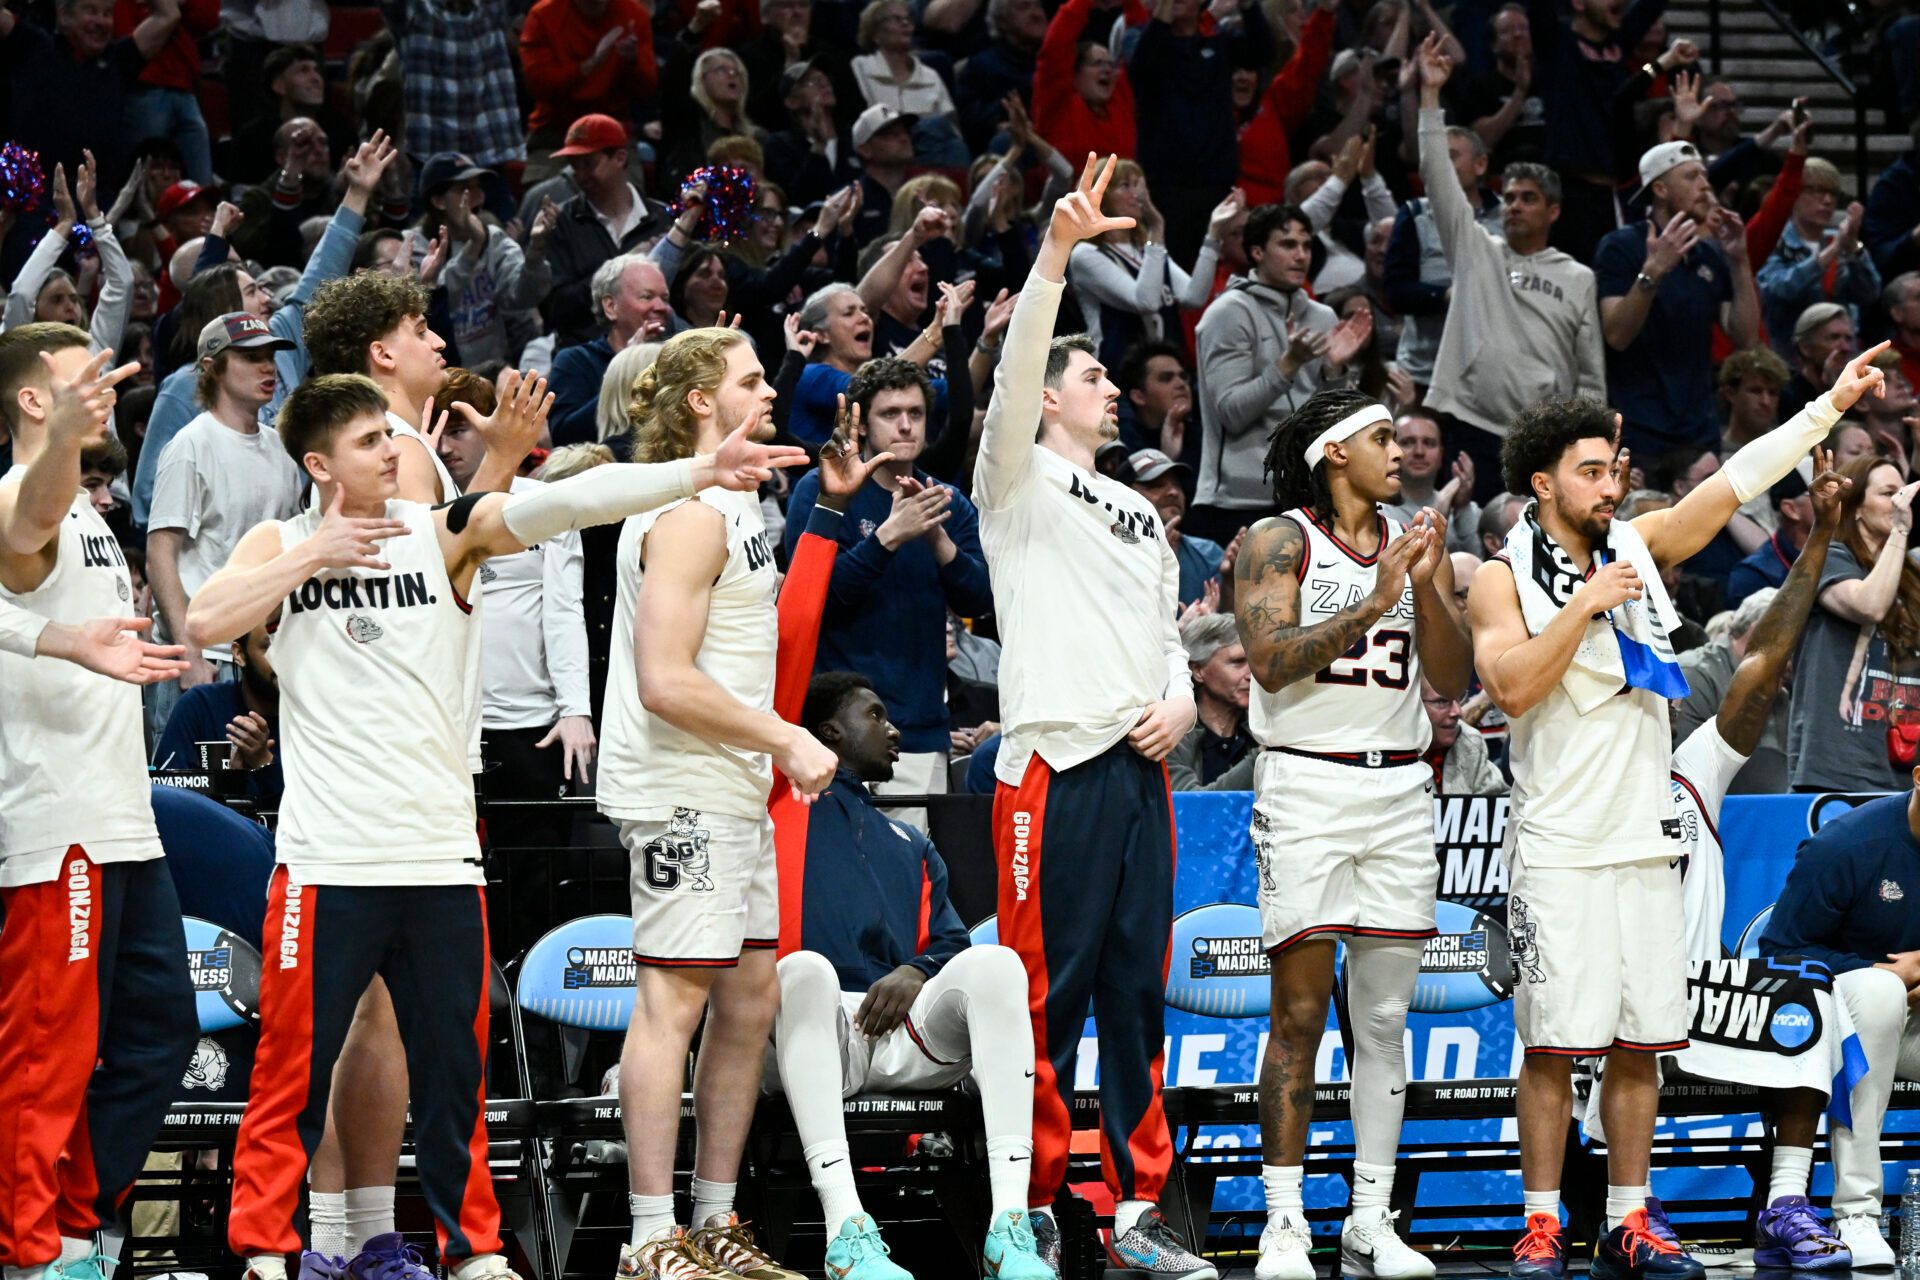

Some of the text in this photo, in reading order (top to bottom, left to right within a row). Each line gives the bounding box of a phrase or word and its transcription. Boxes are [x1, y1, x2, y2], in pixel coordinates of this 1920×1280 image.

[289, 571, 437, 614] LOCK IT IN.
[1310, 579, 1415, 619] ZAS
[1315, 629, 1411, 691] 23
[1366, 751, 1382, 767] G
[1013, 811, 1031, 901] GONZAGA
[642, 843, 681, 891] G
[68, 859, 91, 962] GONZAGA
[1209, 939, 1260, 955] MARCH
[1421, 951, 1487, 966] MADNESS
[1772, 1013, 1810, 1026] NCAA
[1435, 1089, 1452, 1099] THE
[1454, 1088, 1478, 1099] ROAD
[1480, 1088, 1491, 1098] TO
[1493, 1087, 1510, 1098] THE
[1677, 1086, 1689, 1096] TO
[1691, 1086, 1707, 1096] THE
[1709, 1085, 1734, 1096] FINAL
[1893, 1082, 1906, 1091] HE
[1234, 1092, 1251, 1103] THE
[1313, 1090, 1335, 1101] INAL
[858, 1102, 870, 1112] TO
[872, 1101, 889, 1112] THE
[891, 1101, 917, 1111] FINAL
[919, 1101, 943, 1111] FOUR
[1075, 1099, 1087, 1109] TO
[189, 1114, 202, 1125] TO
[203, 1114, 222, 1125] THE
[223, 1114, 244, 1125] FIN
[595, 1108, 612, 1118] THE
